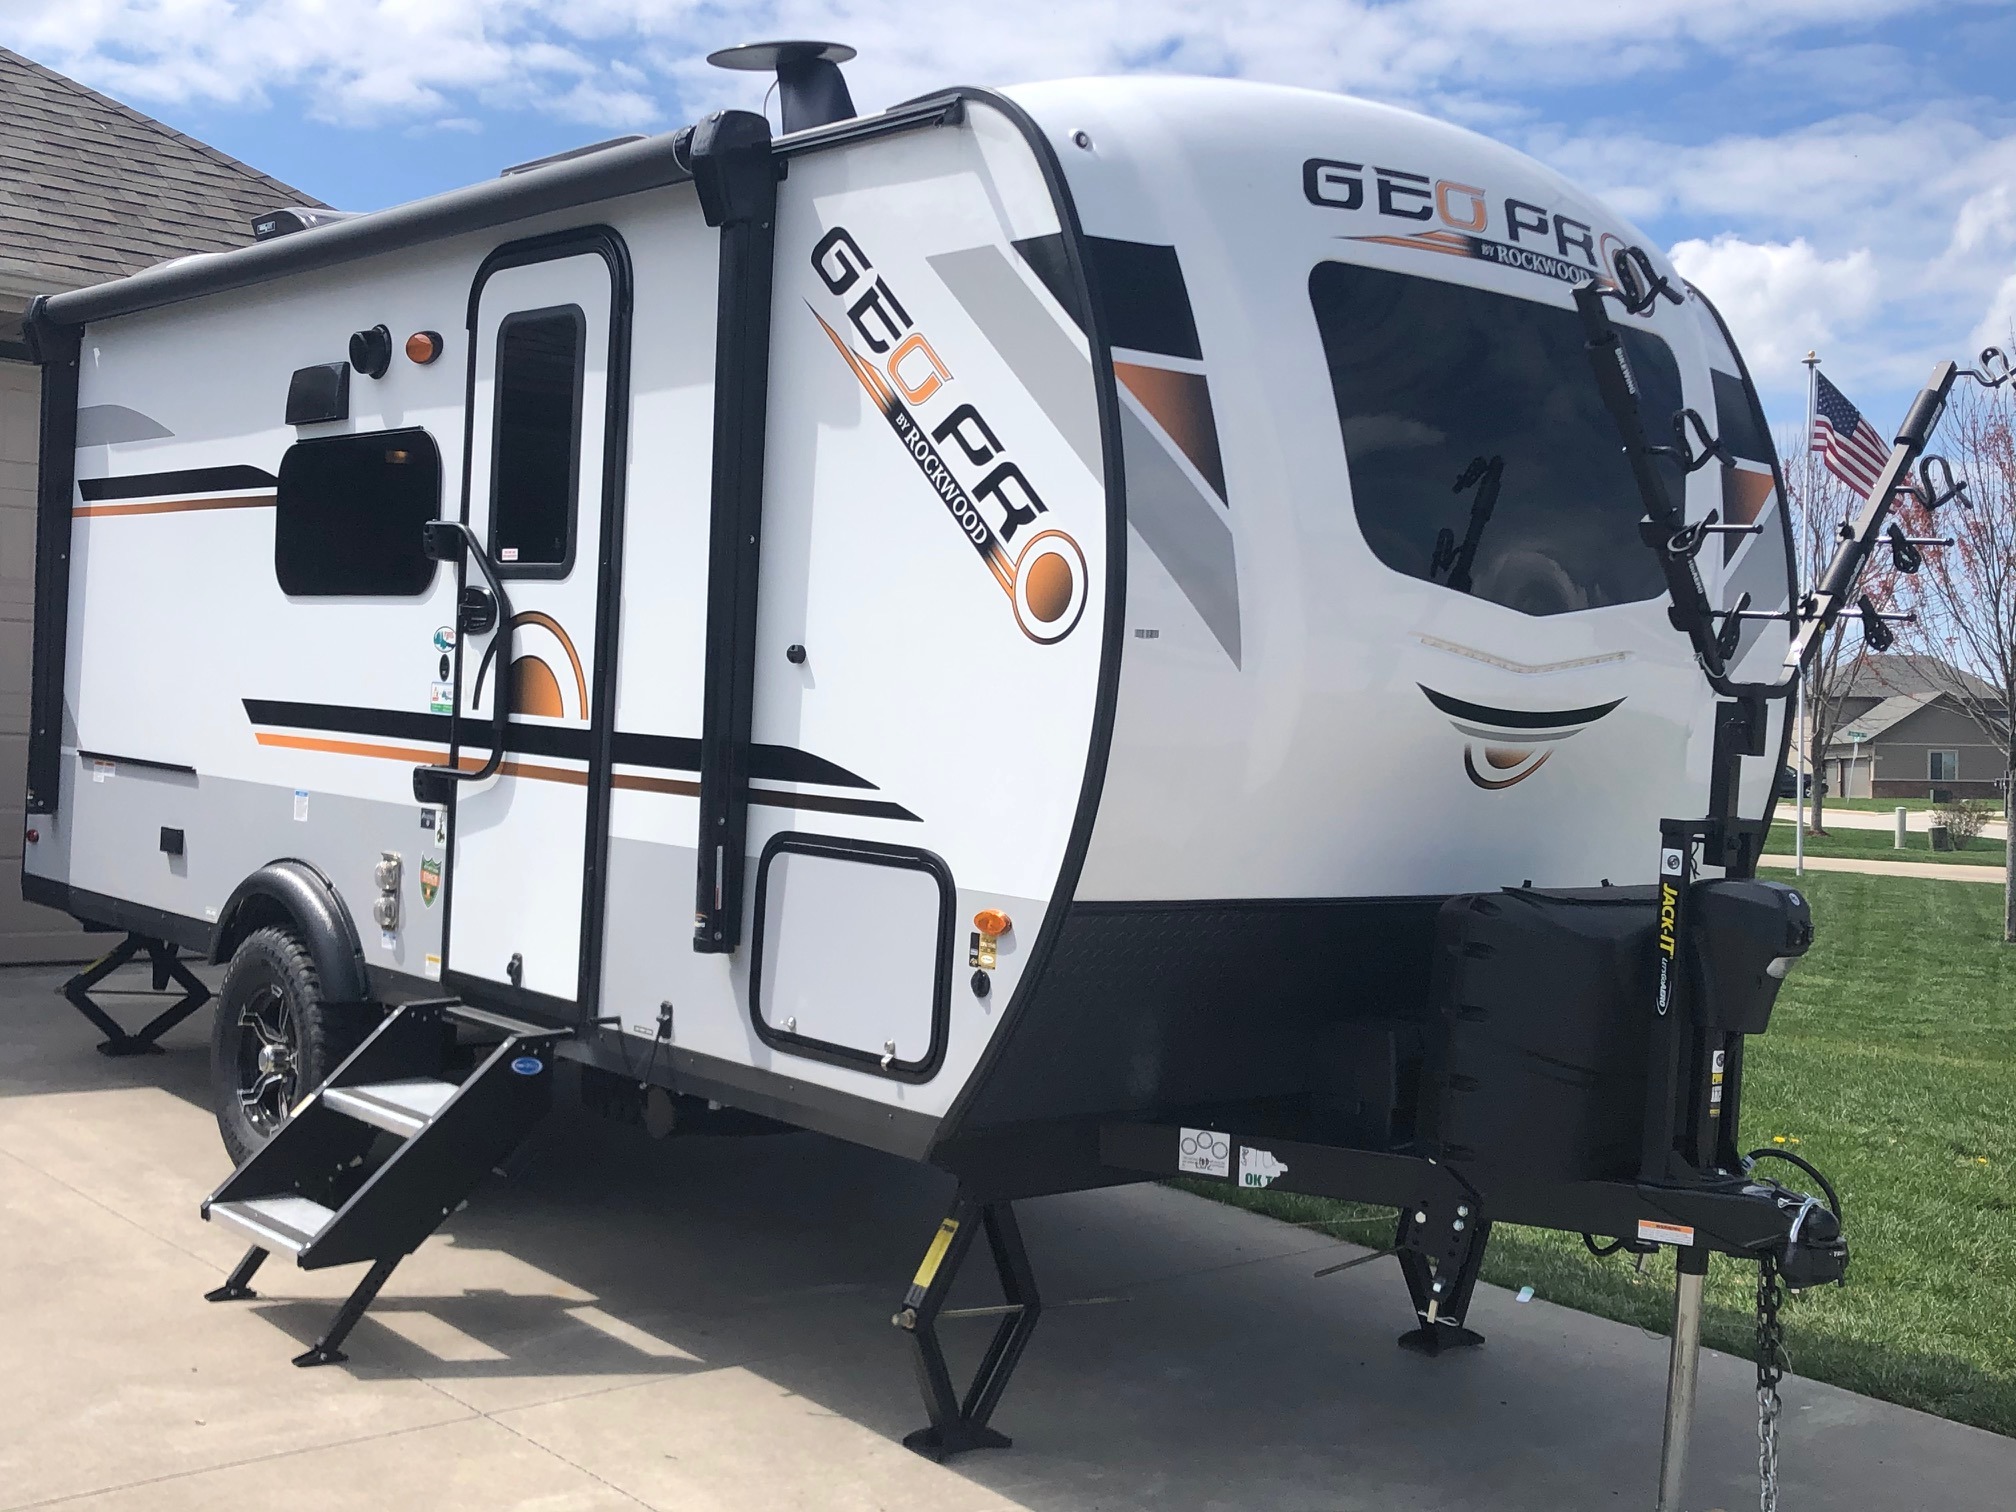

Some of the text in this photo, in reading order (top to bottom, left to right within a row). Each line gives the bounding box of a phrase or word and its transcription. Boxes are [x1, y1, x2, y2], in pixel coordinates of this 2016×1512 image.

[1302, 157, 1489, 233] GEO
[1481, 243, 1592, 284] BY ROCKWOOD
[811, 226, 1089, 645] GEO PRO
[895, 412, 988, 544] BY ROCKWOOD
[1660, 882, 1678, 957] JACK-IT
[1245, 1172, 1262, 1186] OK
